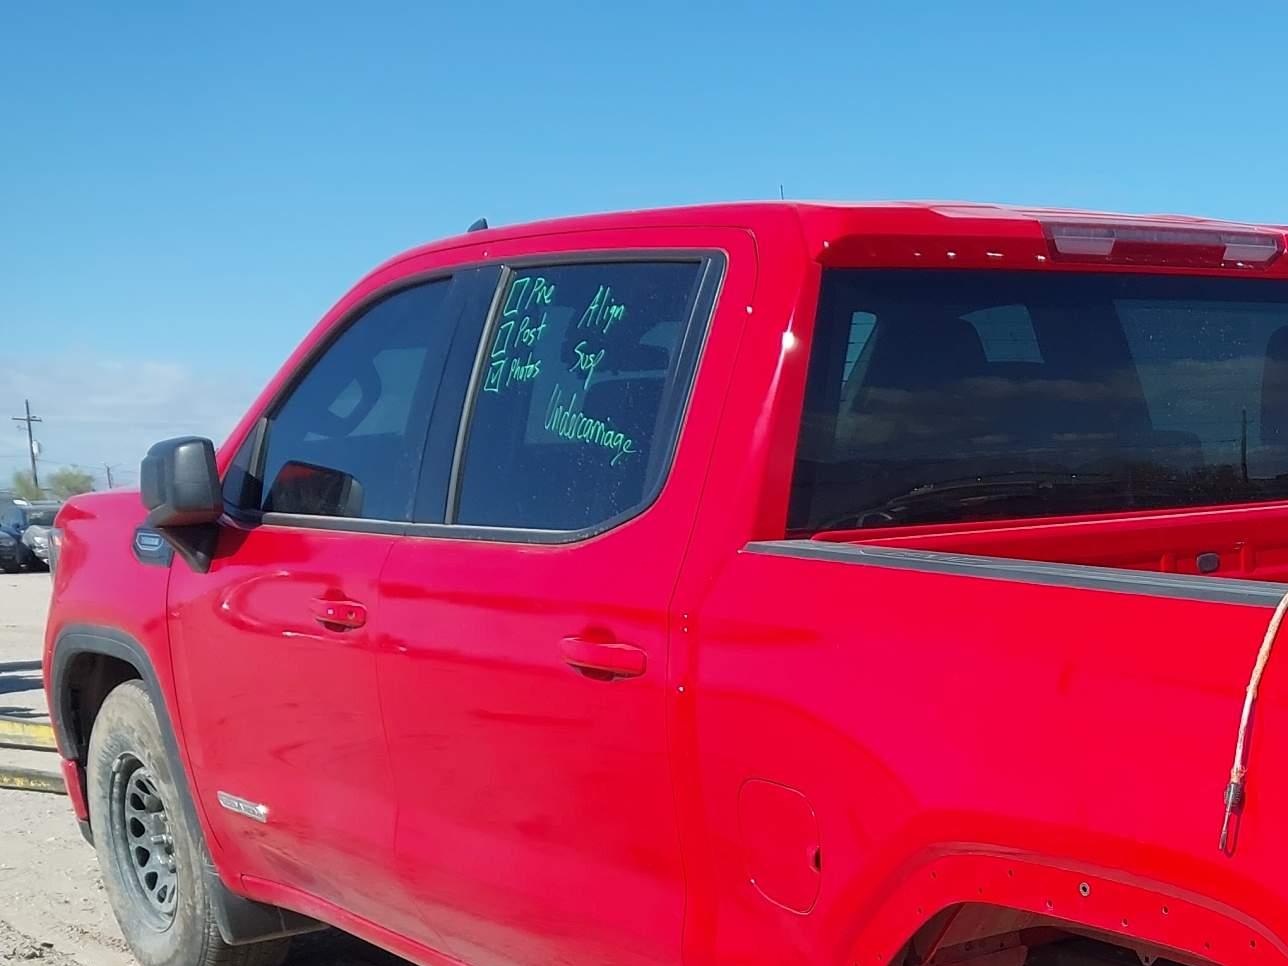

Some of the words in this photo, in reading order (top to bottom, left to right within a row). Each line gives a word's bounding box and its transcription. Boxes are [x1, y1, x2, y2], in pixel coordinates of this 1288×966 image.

[525, 277, 555, 310] Pre
[577, 284, 626, 334] Align
[514, 312, 547, 348] Post
[506, 352, 542, 386] Photos
[569, 341, 605, 390] Susp
